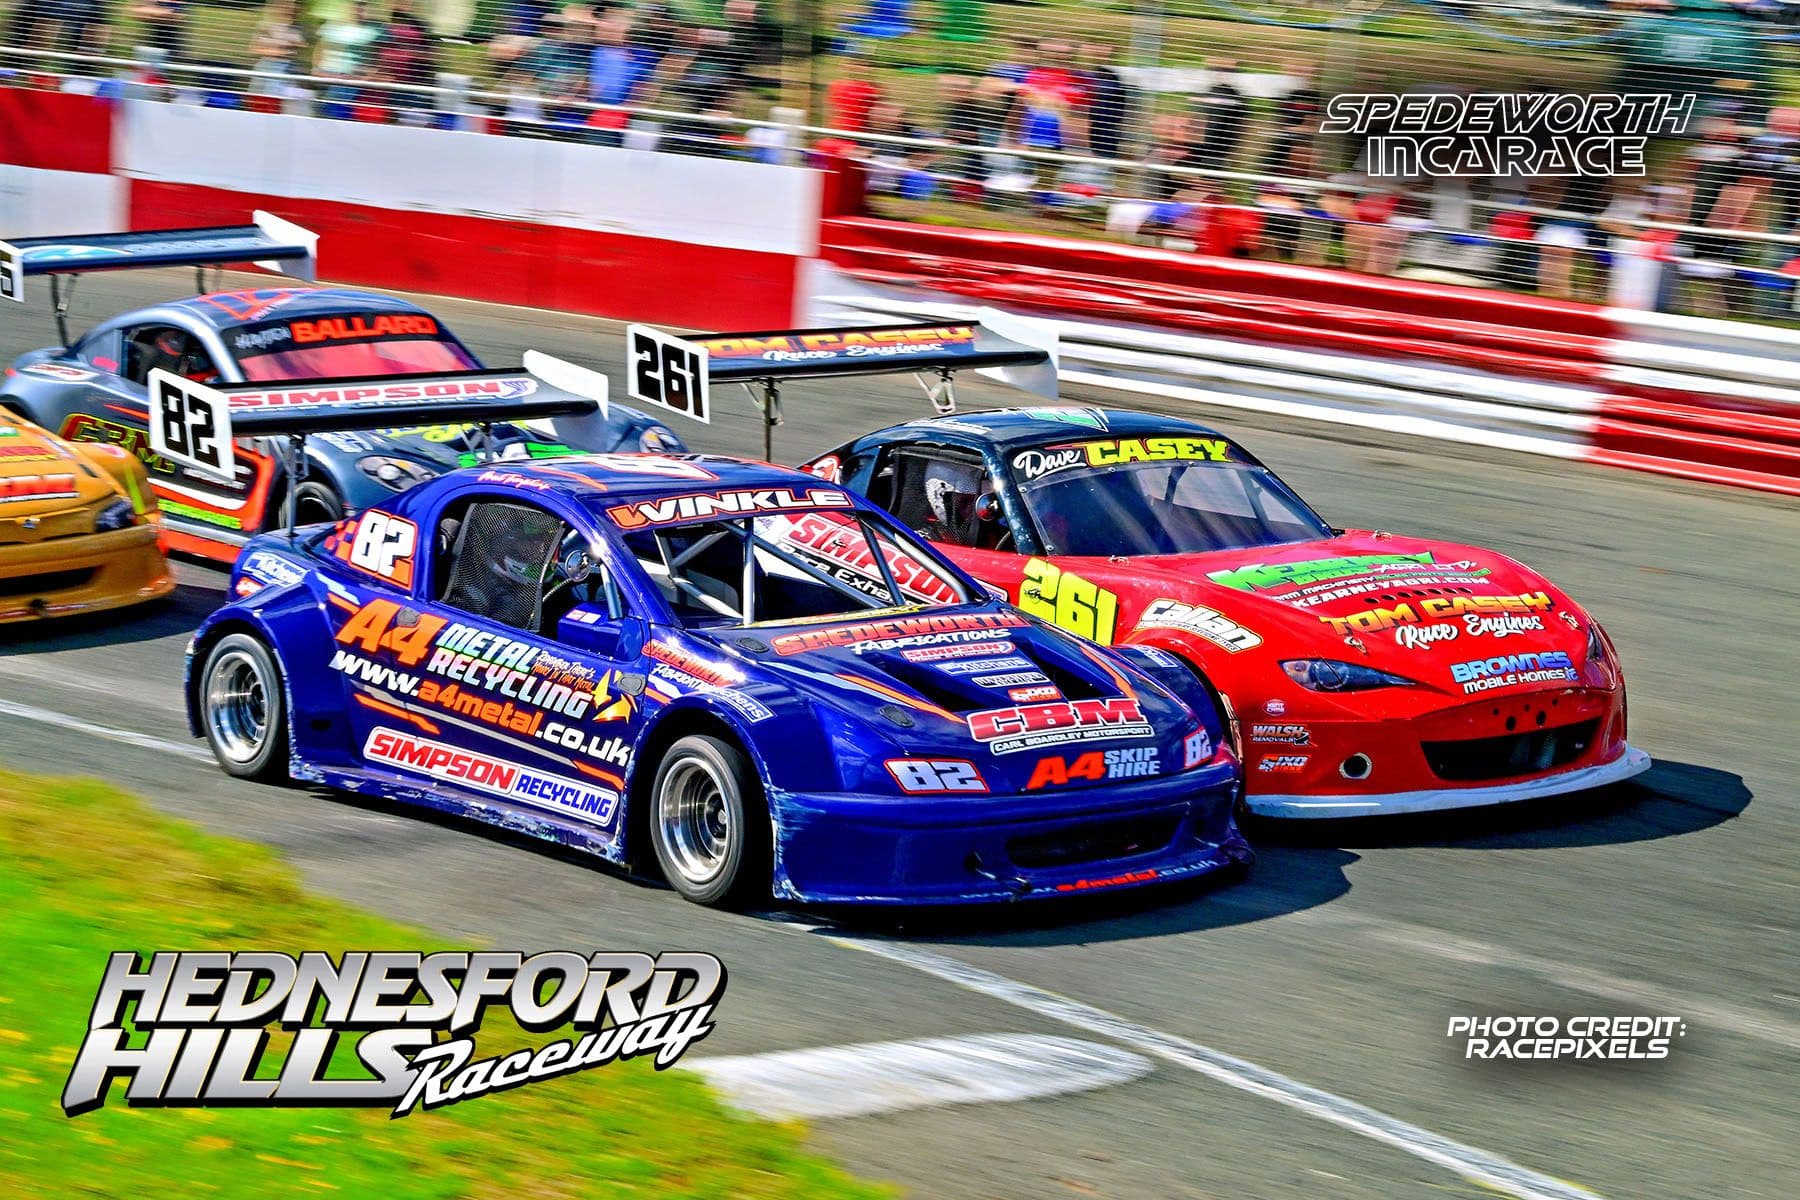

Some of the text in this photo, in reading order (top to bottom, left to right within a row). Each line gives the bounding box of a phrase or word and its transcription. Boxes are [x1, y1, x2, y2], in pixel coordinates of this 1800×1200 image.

[290, 314, 439, 344] BALLARD
[704, 326, 976, 357] OM CASEY
[633, 331, 704, 419] 261
[762, 349, 838, 362] Race
[229, 382, 500, 407] SIMPSON
[160, 379, 221, 468] 82
[1013, 437, 1235, 479] Dave CASEY
[608, 489, 852, 529] WINKLE
[350, 511, 416, 588] 82
[1019, 557, 1118, 647] 261
[1319, 592, 1554, 636] TOM CASEY
[335, 598, 543, 673] A4 METAL
[772, 613, 1031, 657] SPEDEWORTH
[844, 628, 1011, 655] FABRICATIONS
[906, 642, 1000, 657] SIMPSON
[1395, 612, 1545, 650] Race Engines
[426, 647, 593, 719] RECYCLING
[1463, 674, 1518, 694] MOBILE
[1518, 668, 1565, 683] HOMES
[328, 651, 632, 768] www.a4metal.co.uk
[967, 700, 1147, 741] CBM
[994, 740, 1024, 752] CARL
[1084, 726, 1151, 739] MOTORSPORT
[1185, 729, 1212, 766] 82
[1252, 725, 1304, 738] WALSH
[370, 733, 612, 818] SIMPSON RECYCLING
[890, 760, 988, 793] 82
[1026, 747, 1158, 790] A4 SKIP
[1108, 760, 1161, 779] HIRE
